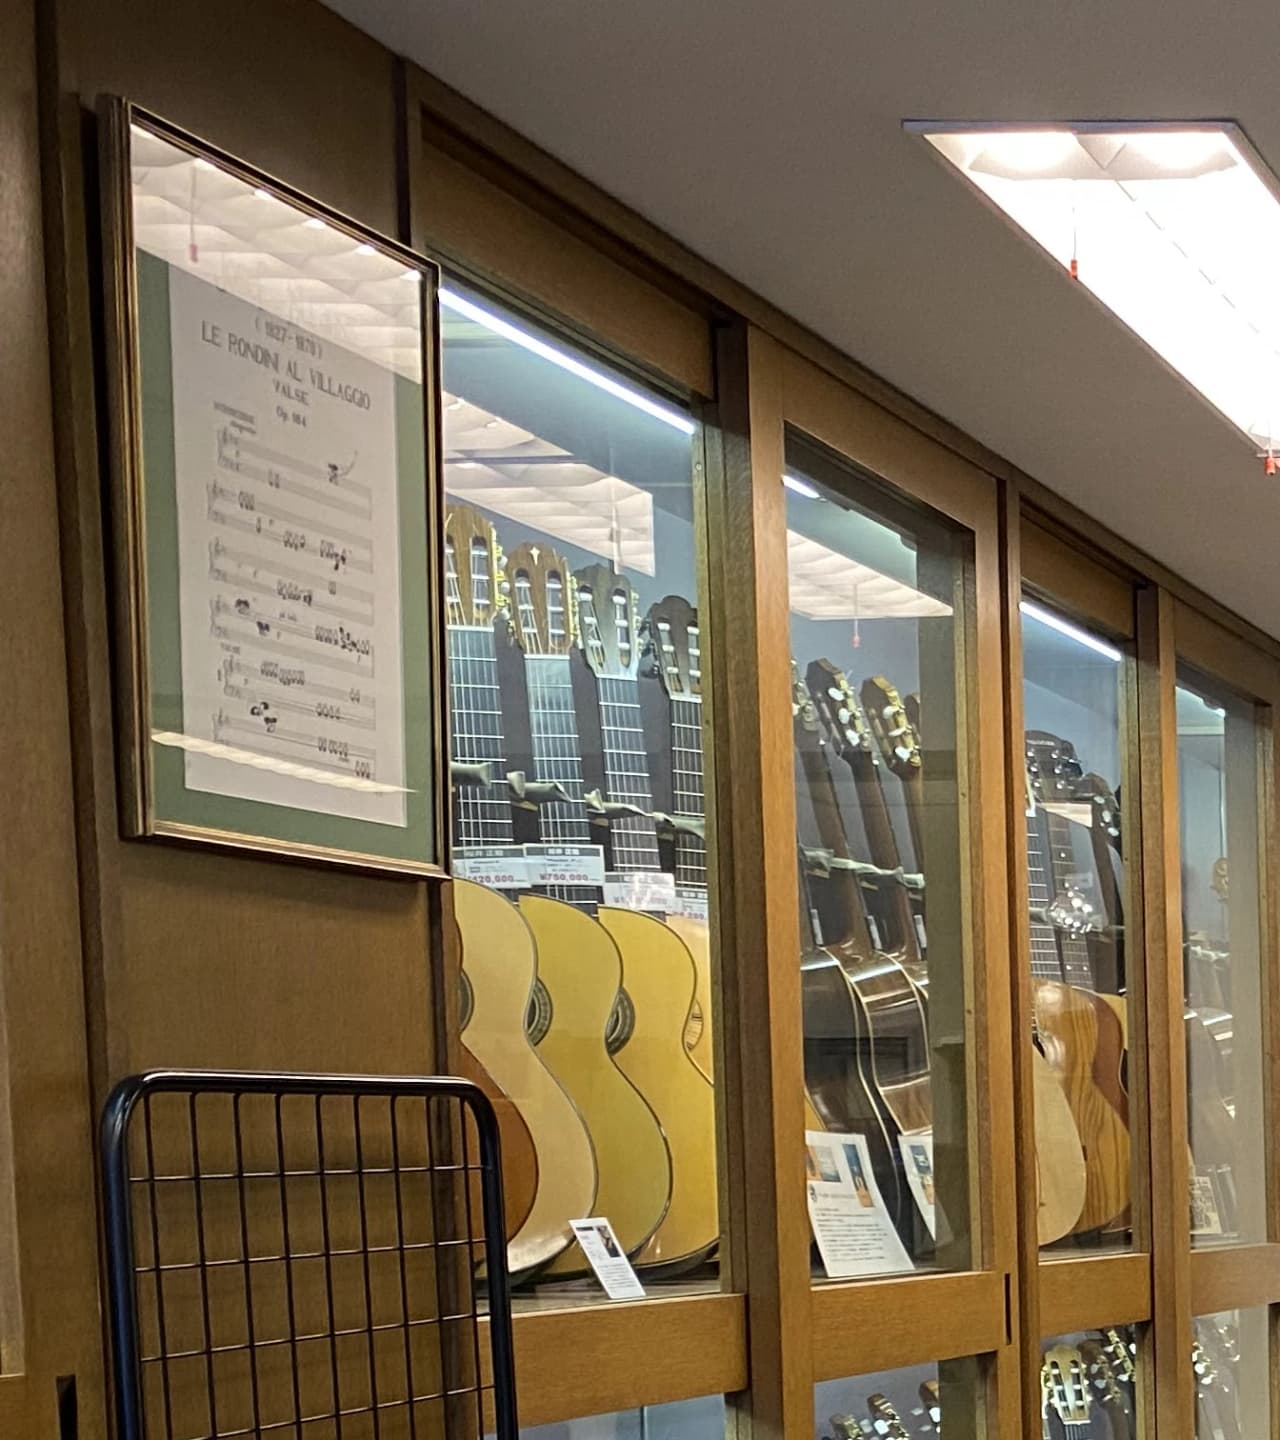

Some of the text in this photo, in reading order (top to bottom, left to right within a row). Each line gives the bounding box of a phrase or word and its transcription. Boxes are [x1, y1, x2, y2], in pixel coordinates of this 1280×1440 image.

[202, 321, 221, 348] LE
[287, 360, 303, 382] AL
[309, 368, 371, 411] VILLAGGIO
[273, 378, 310, 407] VALSE
